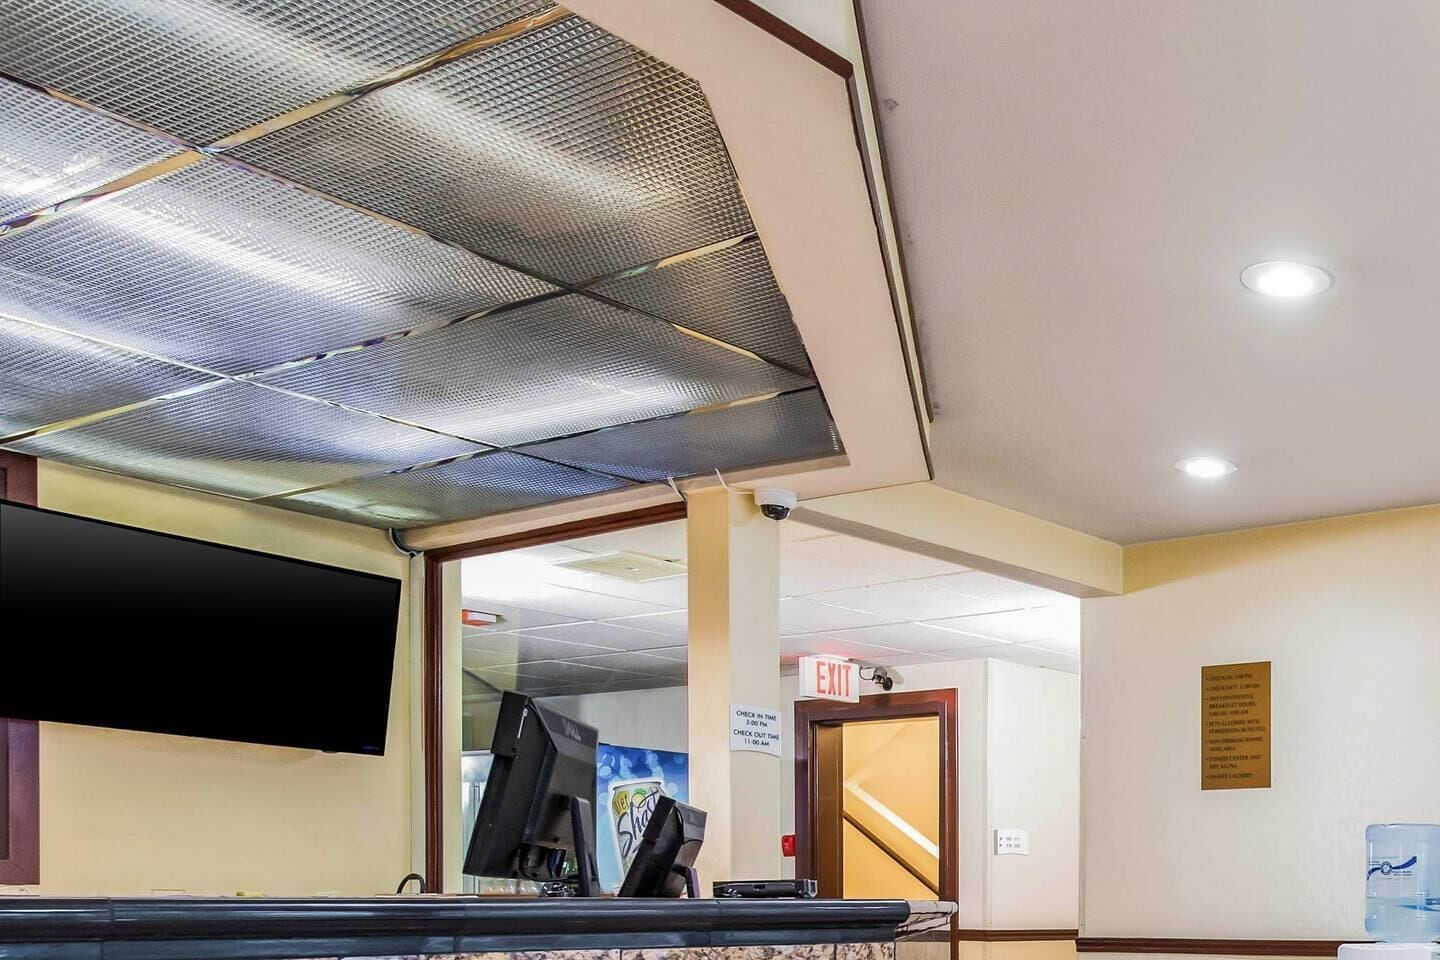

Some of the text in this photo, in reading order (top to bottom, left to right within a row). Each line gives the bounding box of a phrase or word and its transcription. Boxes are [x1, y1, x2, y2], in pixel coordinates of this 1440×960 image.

[816, 661, 852, 697] EXIT
[736, 710, 755, 718] CHECK
[733, 728, 753, 737] CHECK
